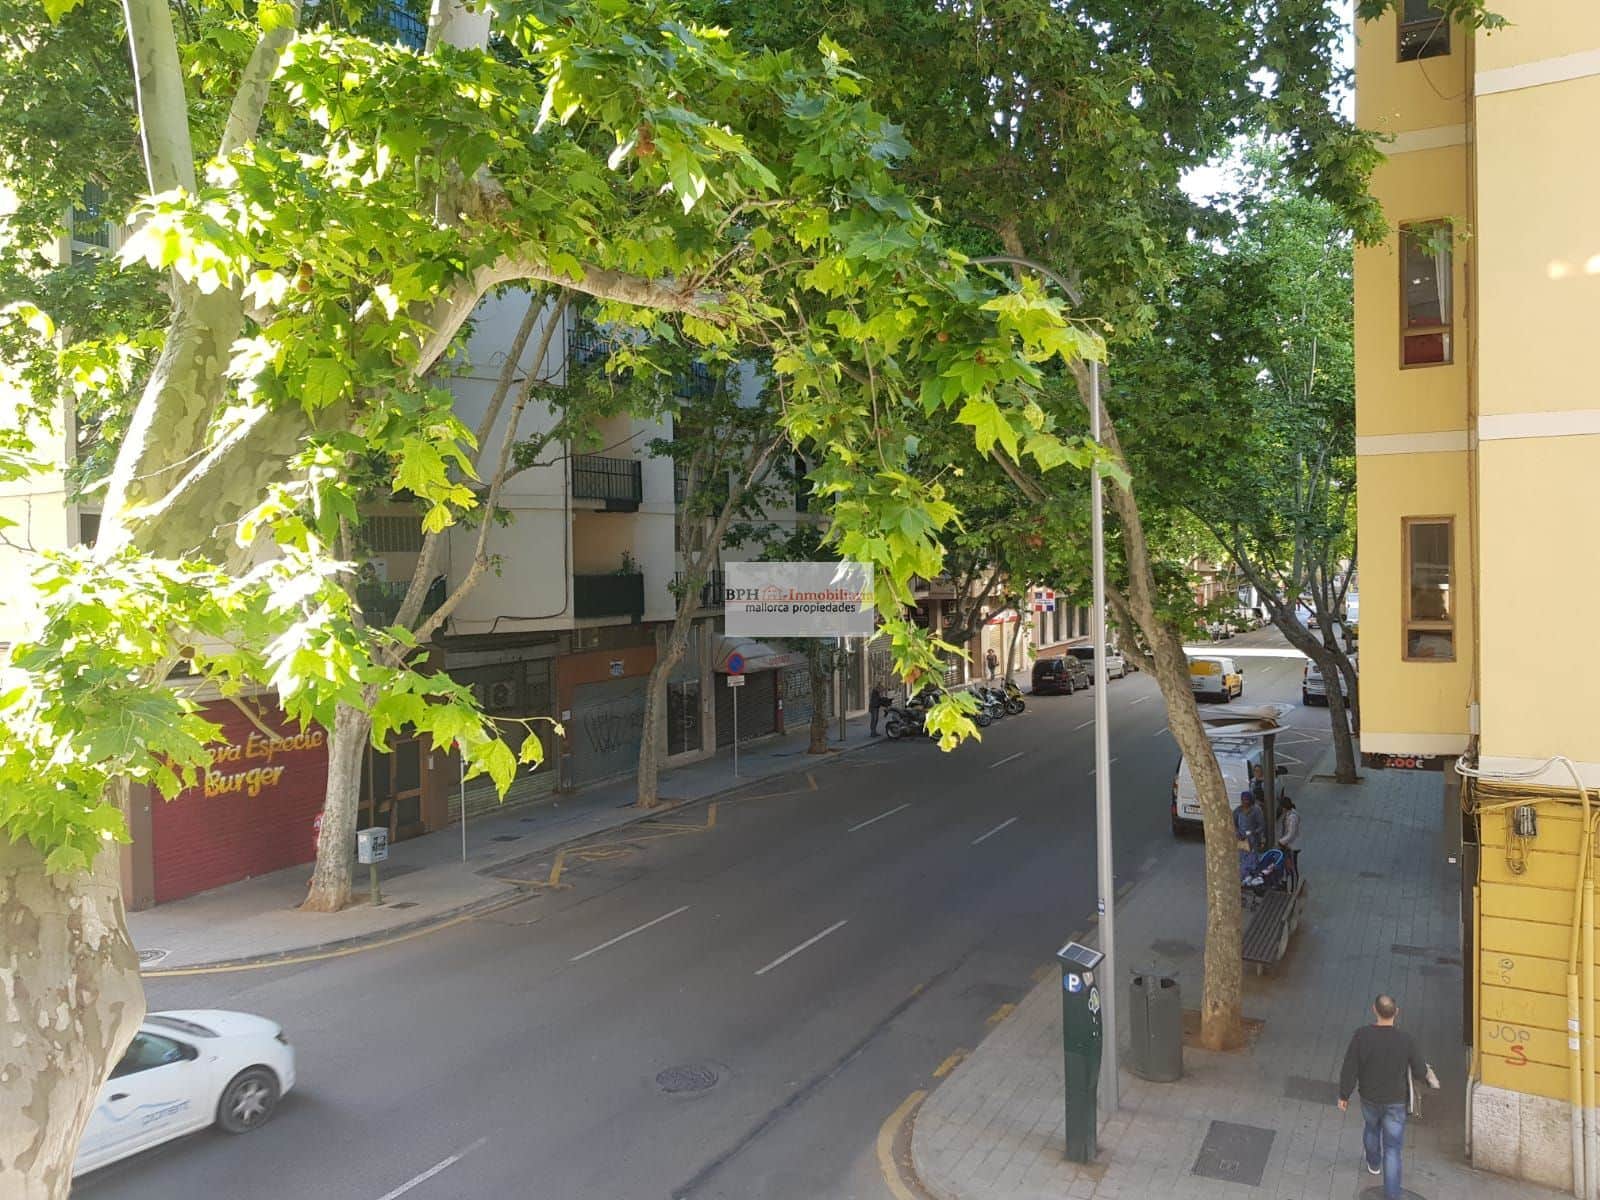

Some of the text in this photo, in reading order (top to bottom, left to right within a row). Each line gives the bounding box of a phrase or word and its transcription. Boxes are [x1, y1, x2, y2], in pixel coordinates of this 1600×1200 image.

[245, 730, 323, 764] Especie
[205, 765, 285, 798] Burger
[1068, 972, 1080, 992] P
